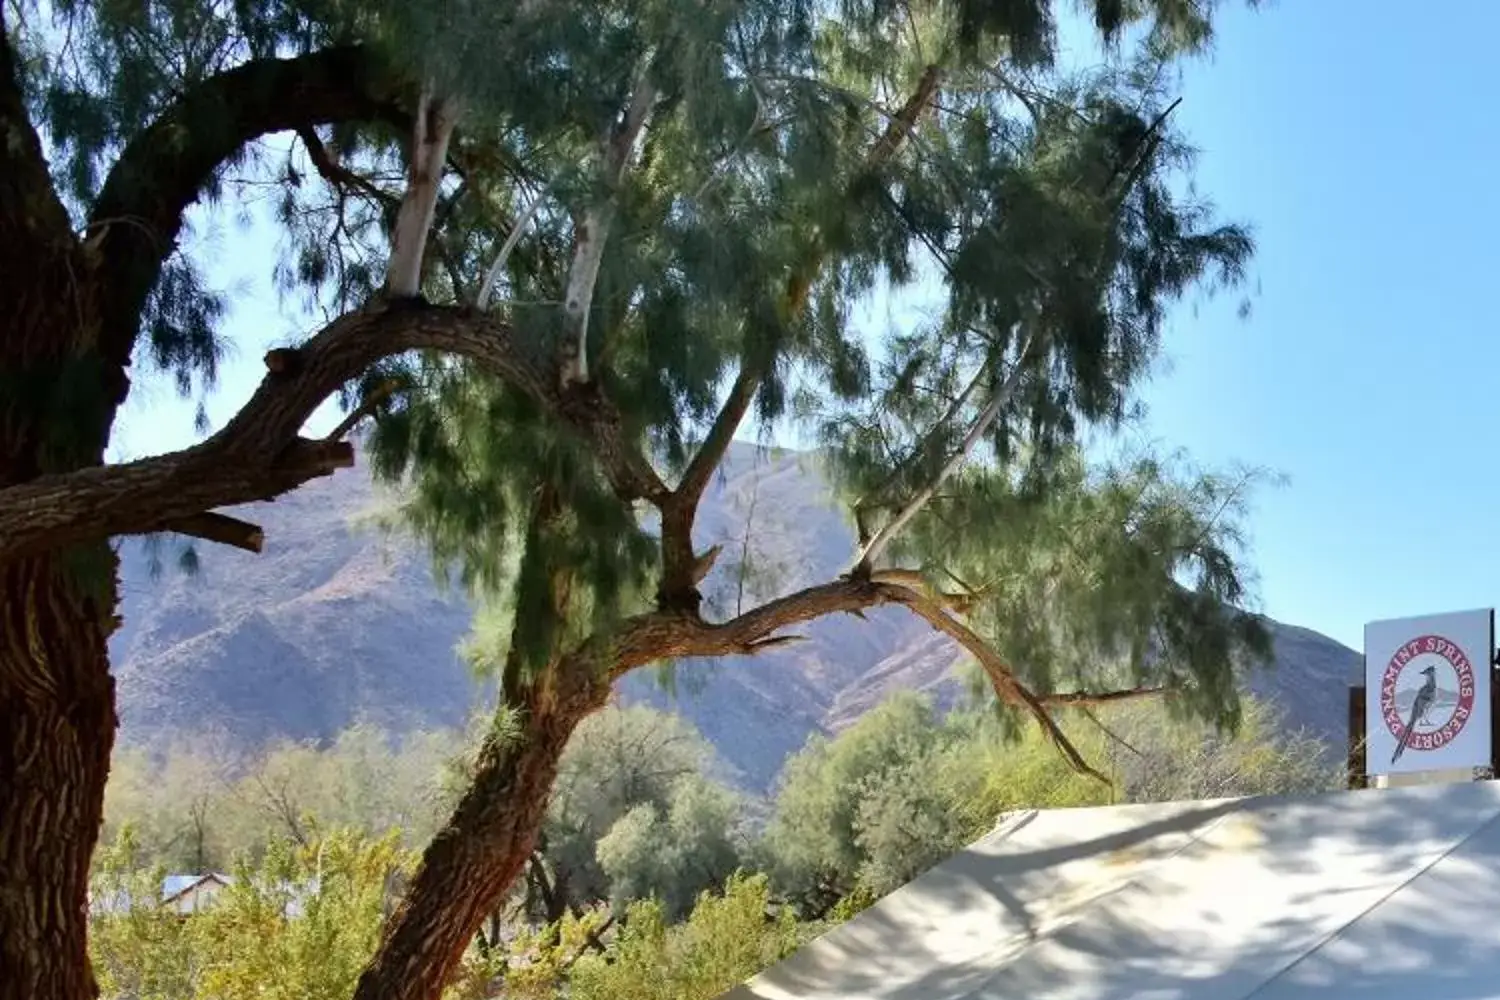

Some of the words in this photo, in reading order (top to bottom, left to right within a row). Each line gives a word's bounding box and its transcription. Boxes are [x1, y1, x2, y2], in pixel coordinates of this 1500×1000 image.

[1382, 641, 1420, 735] PANAMINT
[1426, 637, 1474, 698] SPRINGS
[1411, 706, 1469, 750] RESORT
